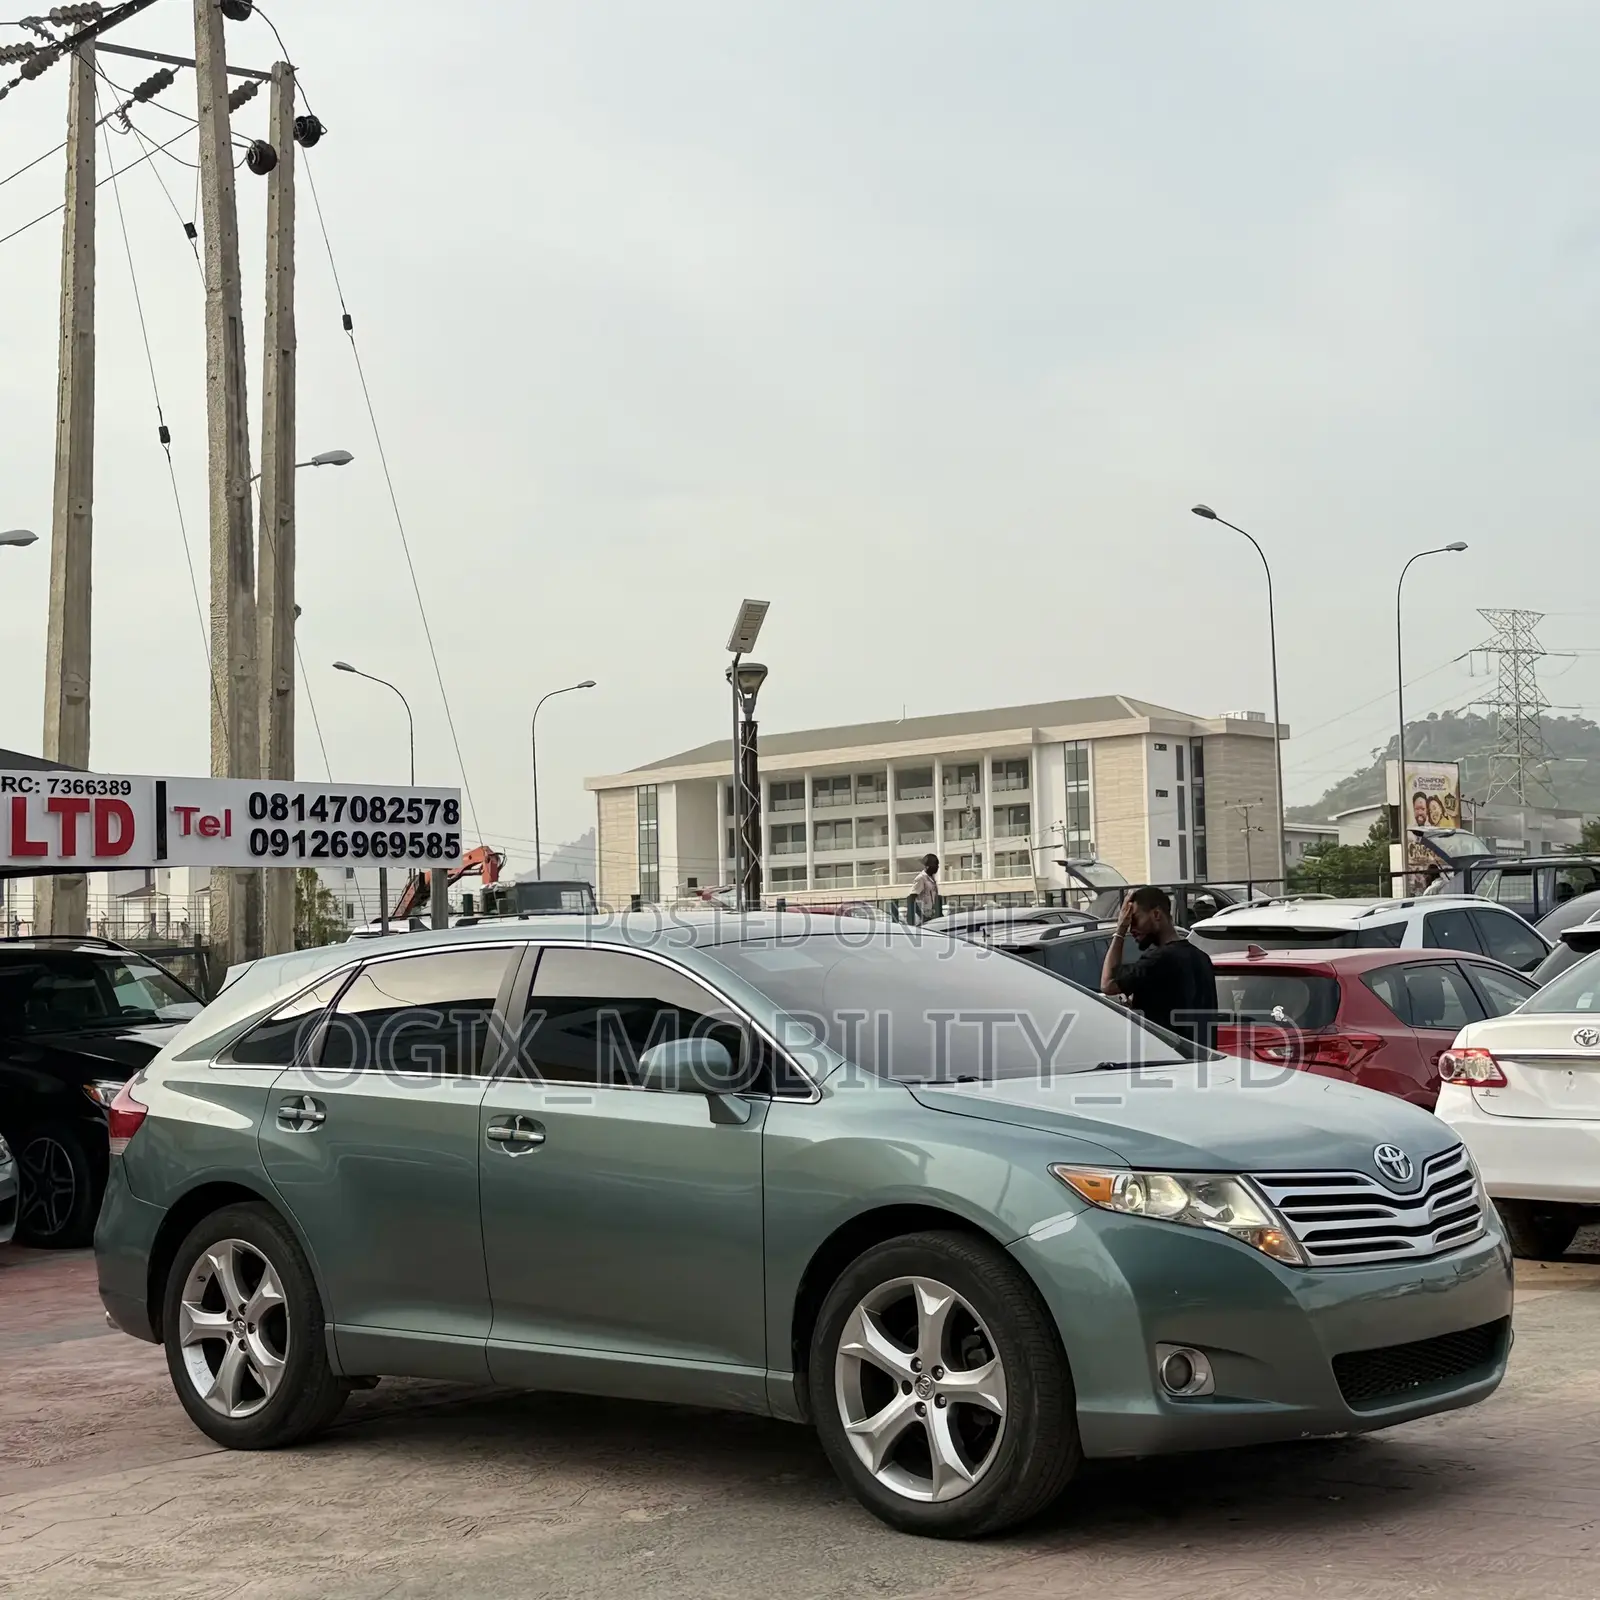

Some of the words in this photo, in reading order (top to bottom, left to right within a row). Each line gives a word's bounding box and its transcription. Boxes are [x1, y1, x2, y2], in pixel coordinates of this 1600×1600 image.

[1, 776, 41, 794] RC:
[47, 778, 132, 796] 7366389
[172, 806, 232, 837] Tel
[248, 791, 460, 825] 08147082578
[9, 797, 136, 857] LTD
[249, 828, 461, 859] 09126969585
